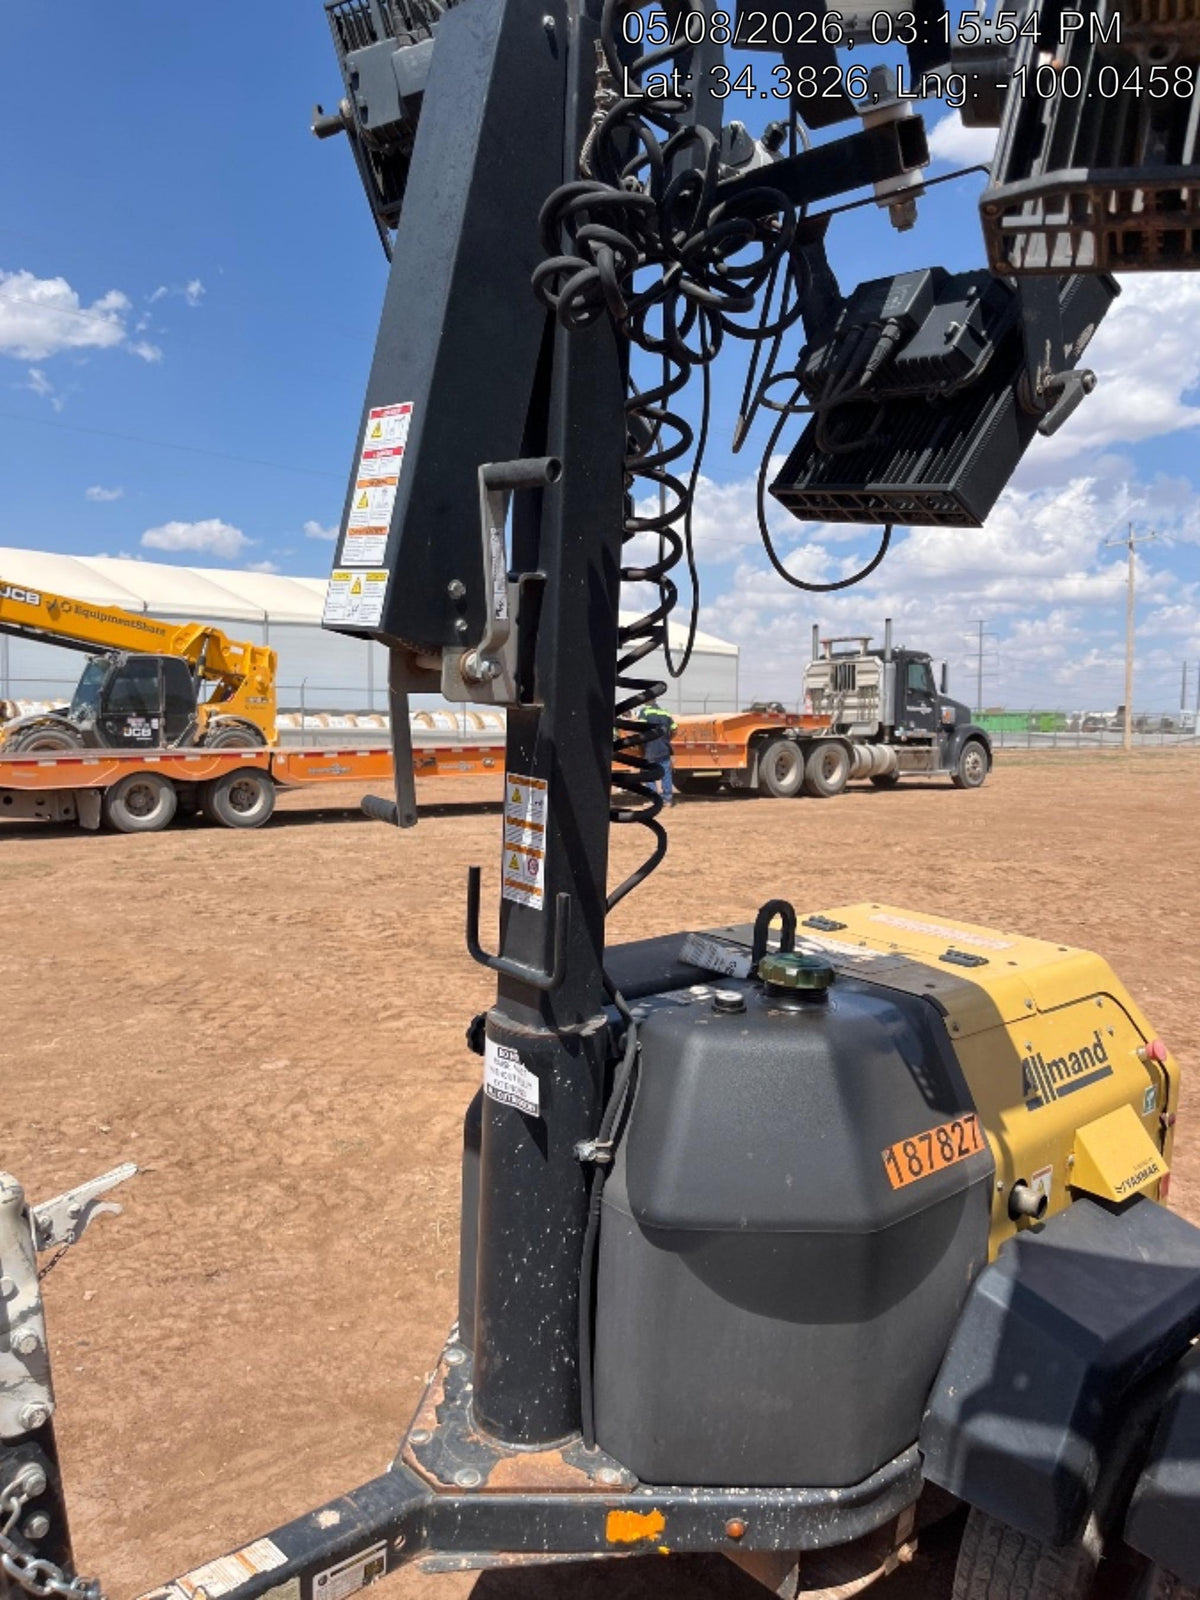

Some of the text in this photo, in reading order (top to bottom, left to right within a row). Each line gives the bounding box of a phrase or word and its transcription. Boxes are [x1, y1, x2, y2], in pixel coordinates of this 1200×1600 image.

[0, 586, 40, 605] JCB
[74, 605, 167, 636] EquipmentShare
[123, 727, 152, 737] JCB
[1022, 1030, 1109, 1104] Allmand
[886, 1114, 979, 1183] 187827
